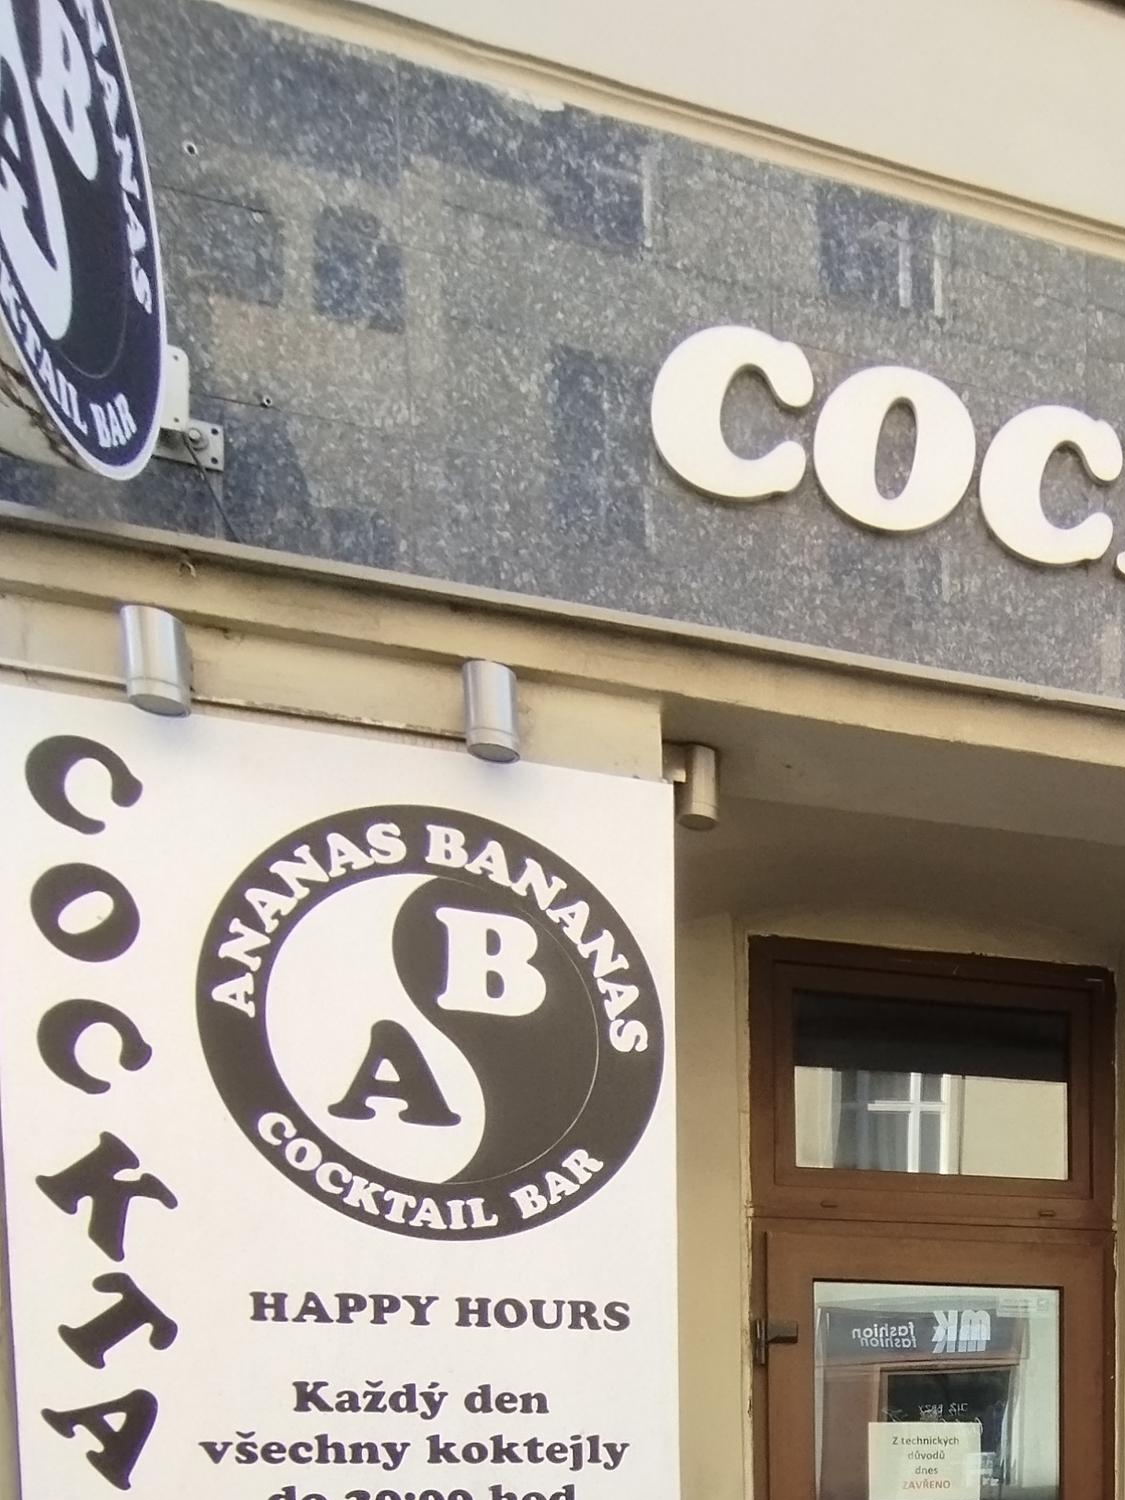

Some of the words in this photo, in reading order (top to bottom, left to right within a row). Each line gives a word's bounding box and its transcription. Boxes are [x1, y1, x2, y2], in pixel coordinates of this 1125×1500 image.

[89, 393, 138, 449] BAR
[211, 823, 407, 1019] ANANAS
[424, 823, 648, 1053] BANANAS
[436, 907, 547, 1017] B
[327, 1019, 462, 1127] A
[257, 1112, 499, 1230] COCKTAIL
[510, 1148, 604, 1220] BAR
[249, 1291, 440, 1328] HAPPY
[455, 1296, 632, 1332] HOURS
[292, 1378, 449, 1419] Každý
[463, 1382, 549, 1415] den
[199, 1431, 411, 1472] všechny
[426, 1433, 630, 1472] koktejly
[892, 1436, 899, 1446] Z
[901, 1436, 960, 1447] technických
[908, 1451, 945, 1460] důvodů
[902, 1479, 951, 1490] ZAVŘENO
[915, 1466, 938, 1475] dnes
